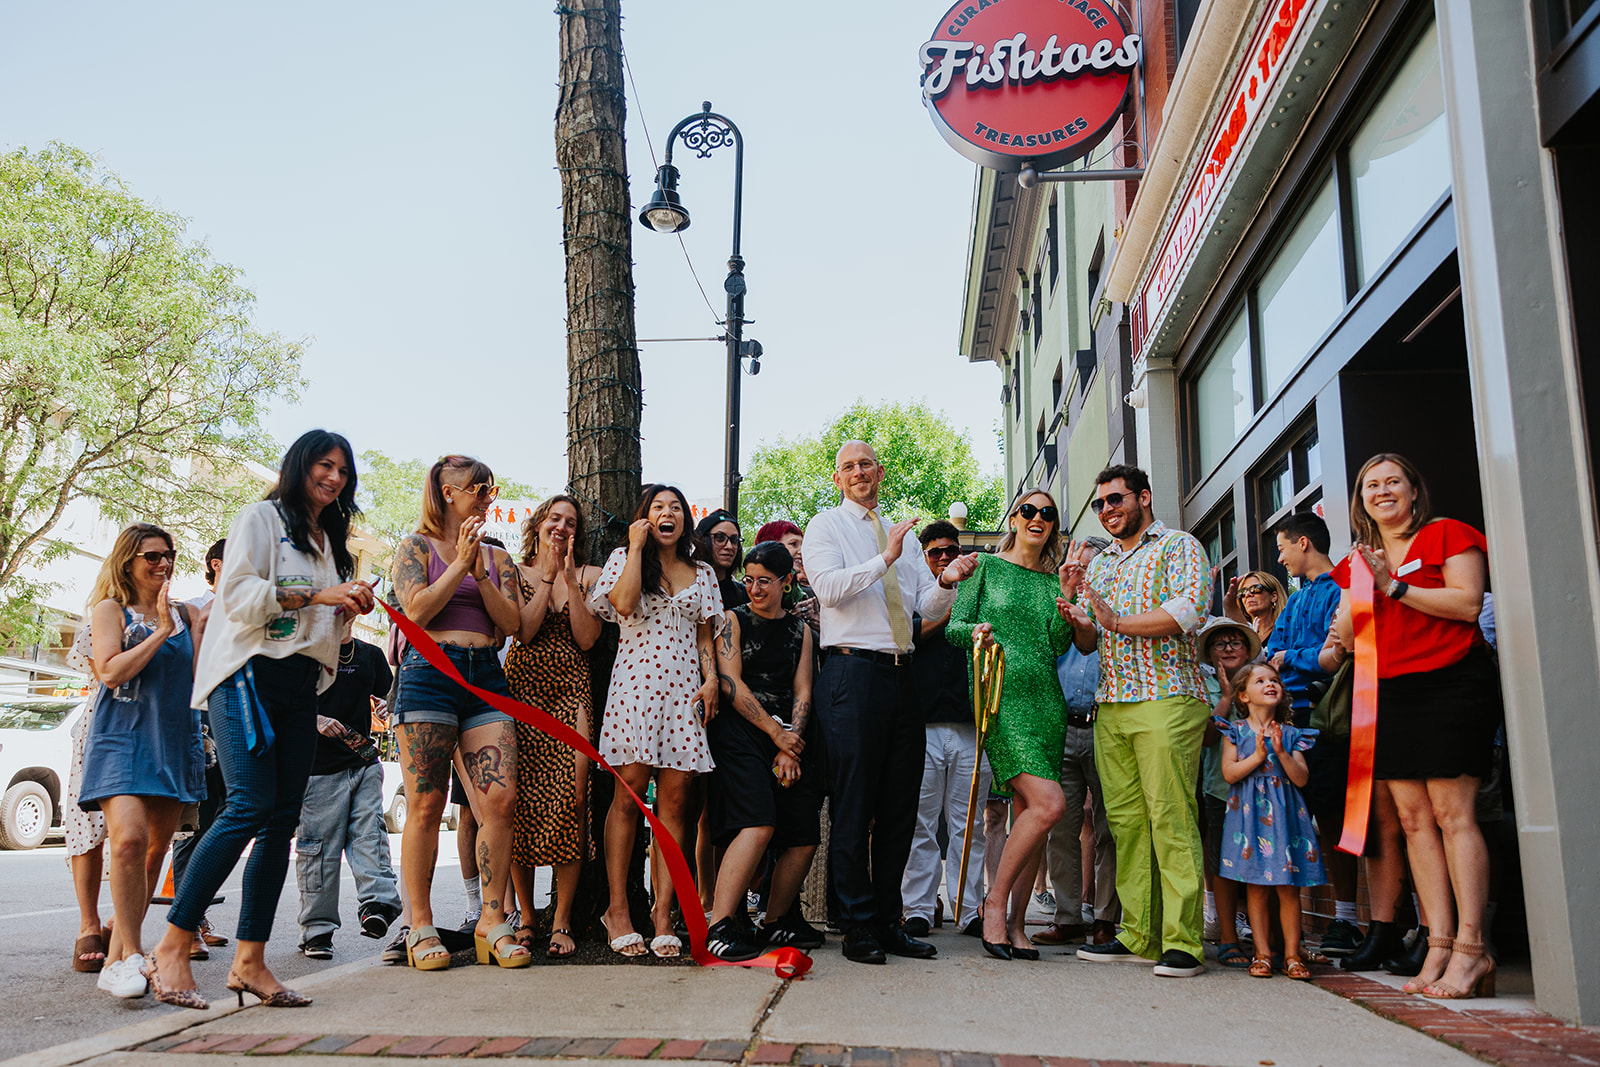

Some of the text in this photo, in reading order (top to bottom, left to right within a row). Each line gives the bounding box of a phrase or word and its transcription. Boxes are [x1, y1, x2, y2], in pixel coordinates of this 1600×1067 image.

[948, 0, 1000, 36] CURA
[919, 32, 1140, 95] Fishtoes
[974, 116, 1088, 147] TREASURES
